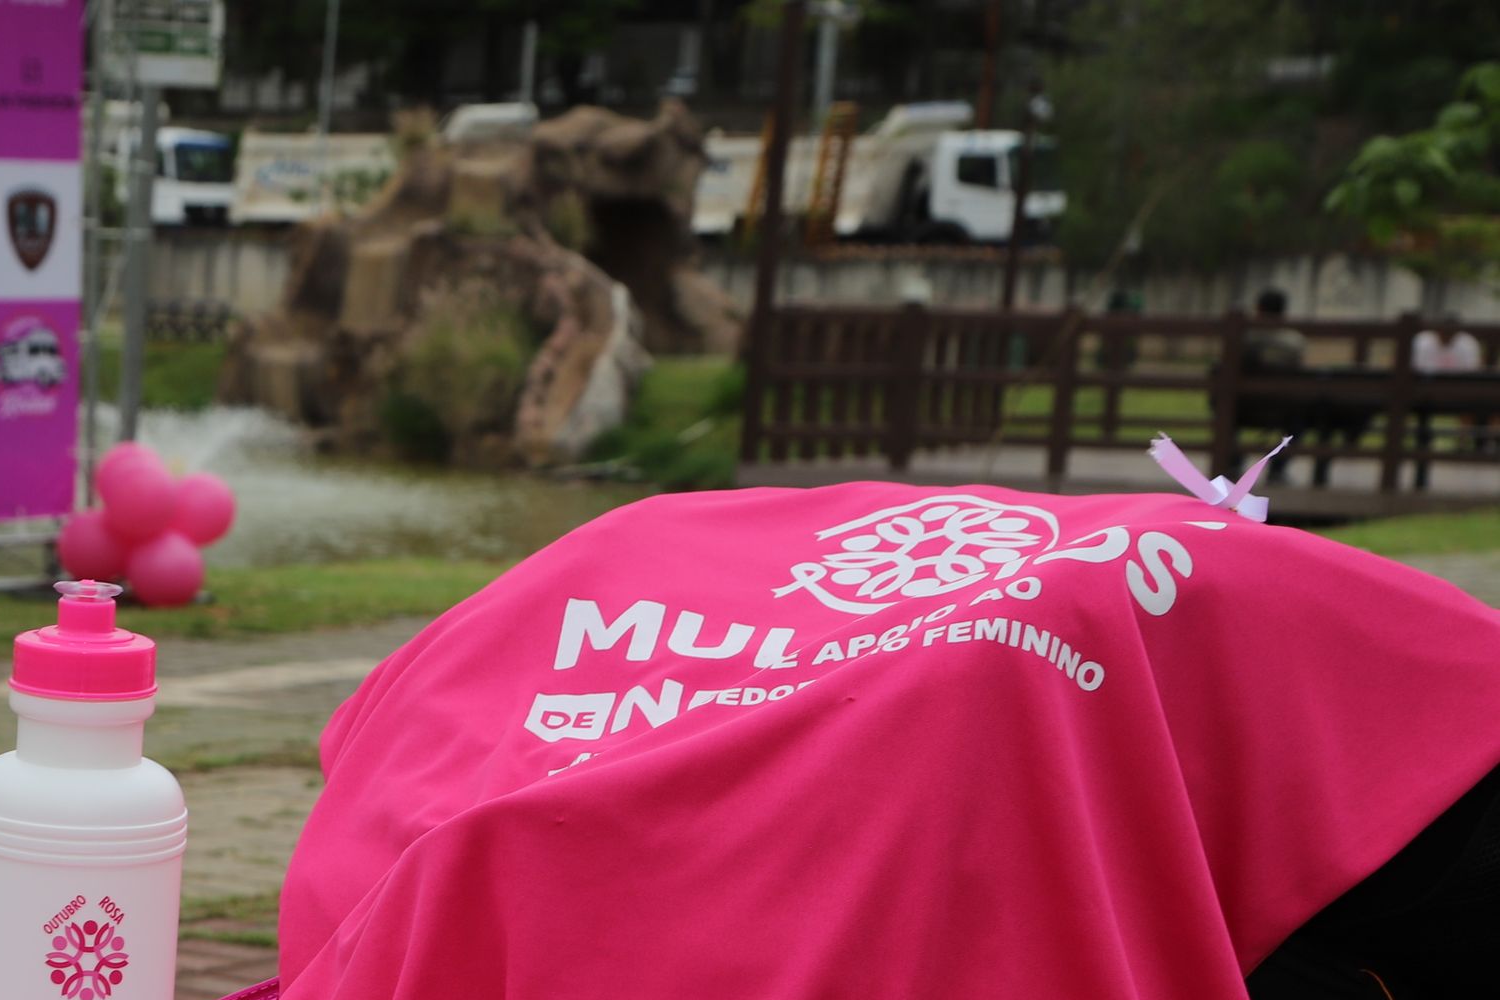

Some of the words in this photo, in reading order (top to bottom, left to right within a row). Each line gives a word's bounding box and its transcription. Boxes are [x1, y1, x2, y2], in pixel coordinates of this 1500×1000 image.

[922, 616, 1106, 692] FEMININO
[539, 710, 597, 730] DE
[43, 894, 87, 935] OUTUBRO
[98, 895, 126, 926] ROSA
